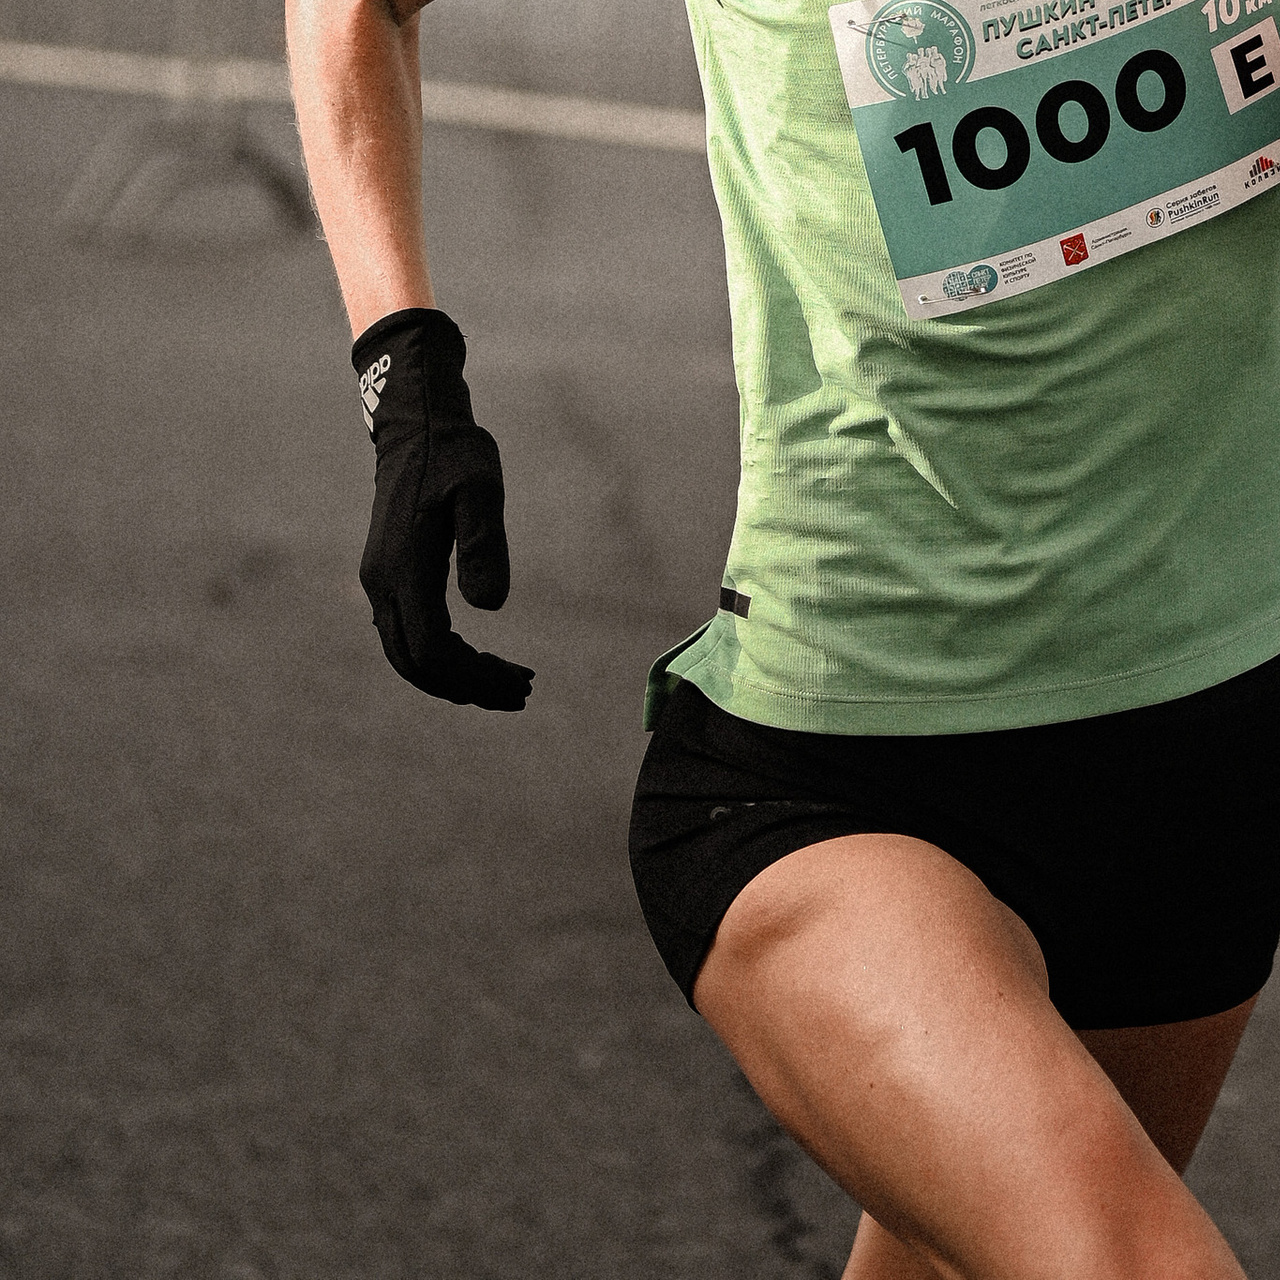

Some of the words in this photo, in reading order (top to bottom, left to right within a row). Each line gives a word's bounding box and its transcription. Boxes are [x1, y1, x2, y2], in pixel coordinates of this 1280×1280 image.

[930, 10, 964, 65] МАРАФОН
[893, 49, 1187, 207] 1000
[1166, 196, 1188, 209] Серия
[1190, 184, 1217, 200] забегов
[1168, 193, 1219, 218] PushkinRun
[999, 255, 1023, 267] КОМИТЕТ
[1001, 257, 1037, 273] ФИЗИЧЕСКОЙ
